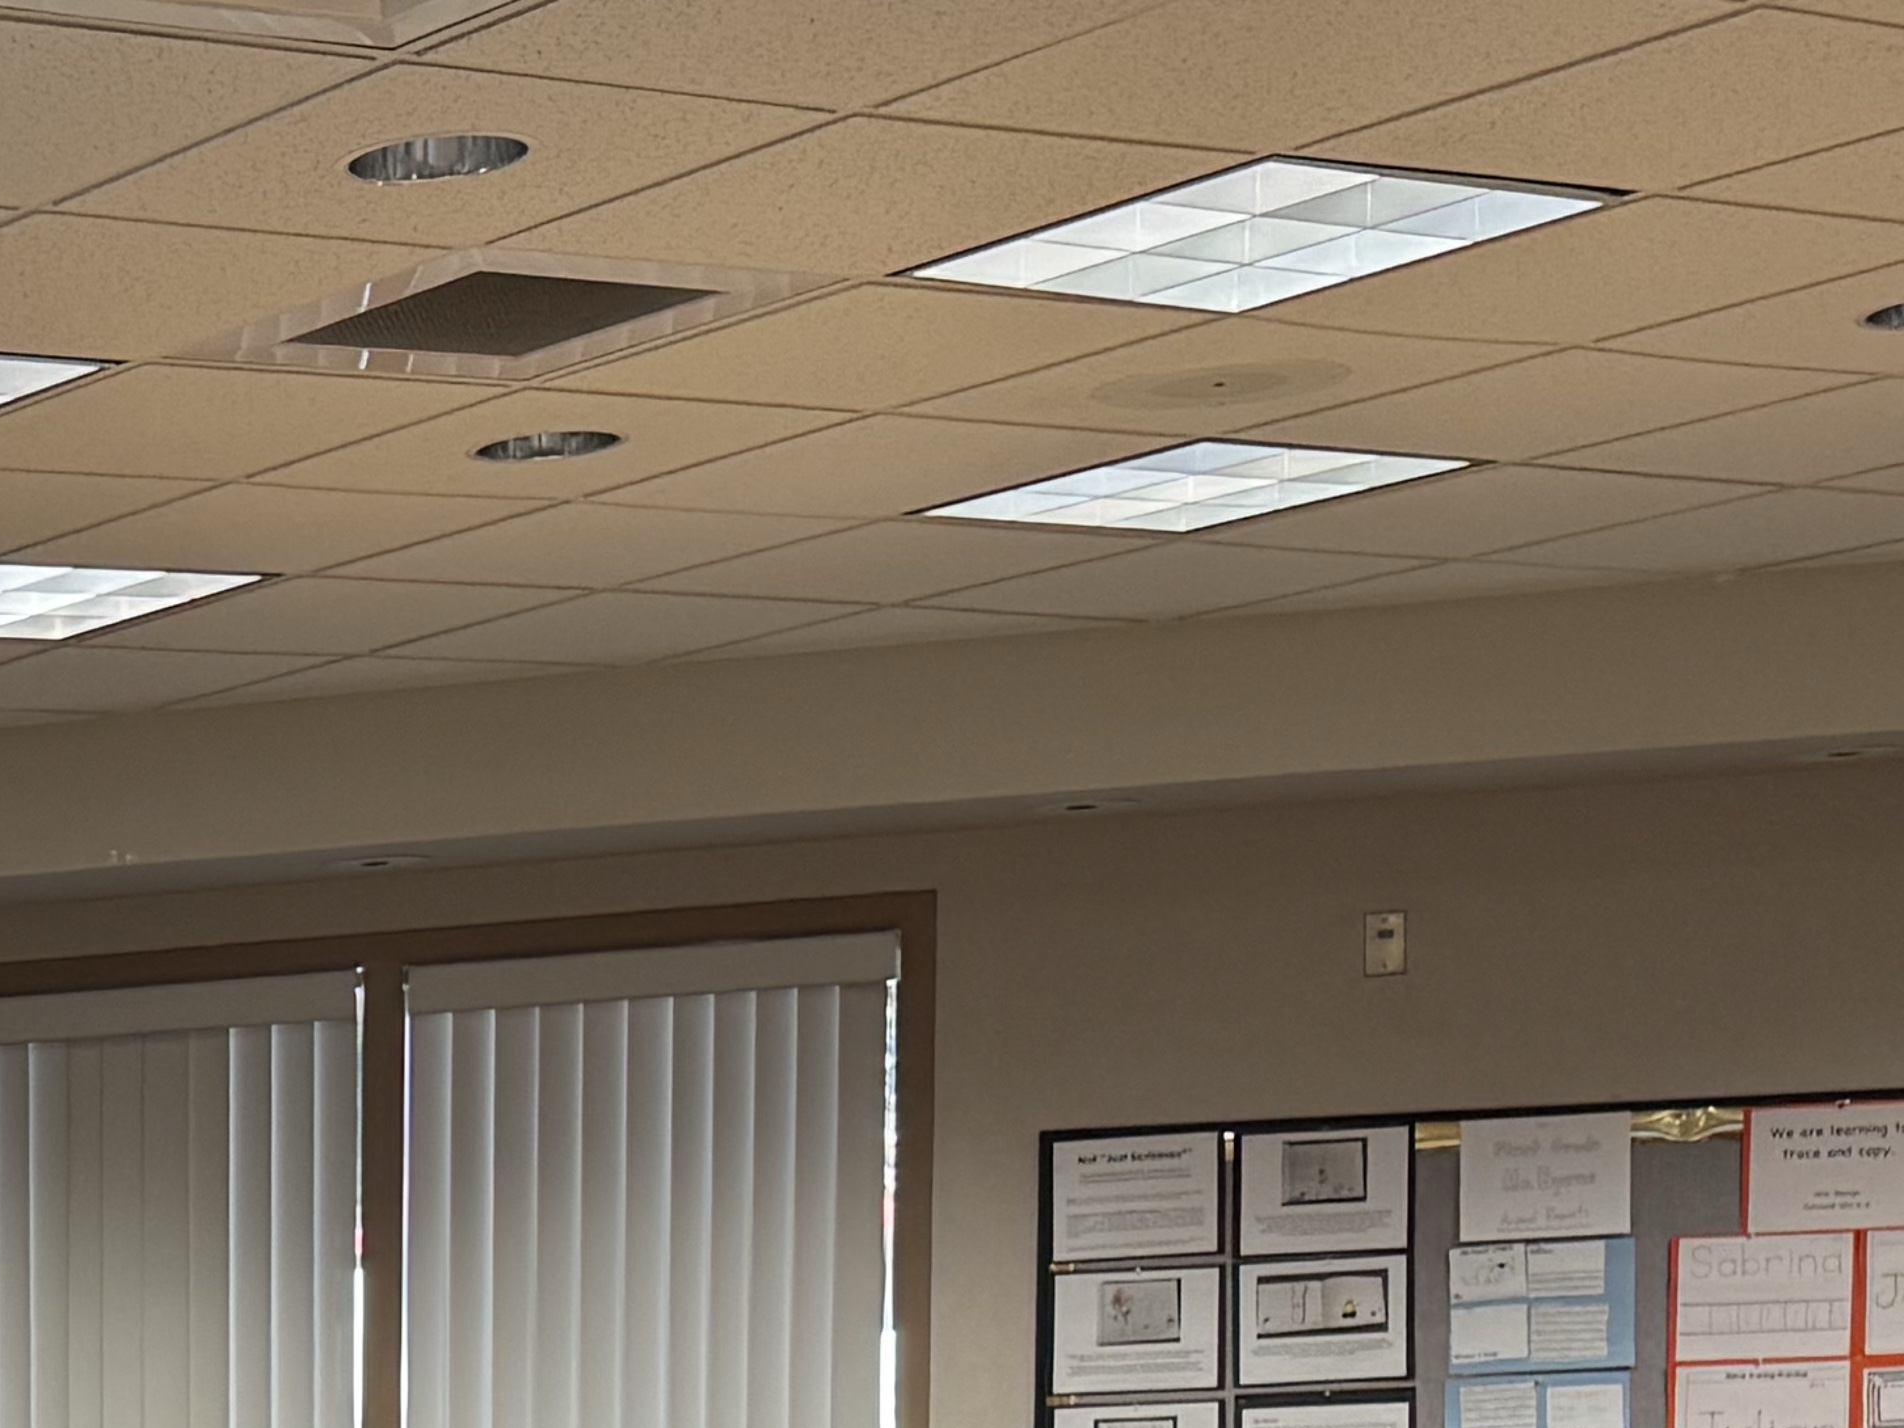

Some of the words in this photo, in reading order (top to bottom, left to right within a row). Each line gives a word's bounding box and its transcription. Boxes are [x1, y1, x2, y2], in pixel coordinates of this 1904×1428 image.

[1770, 1126, 1794, 1140] We
[1799, 1127, 1824, 1138] are
[1830, 1124, 1889, 1139] learning
[1783, 1148, 1821, 1160] trace
[1827, 1146, 1853, 1159] and
[1691, 1243, 1844, 1280] Sabrina
